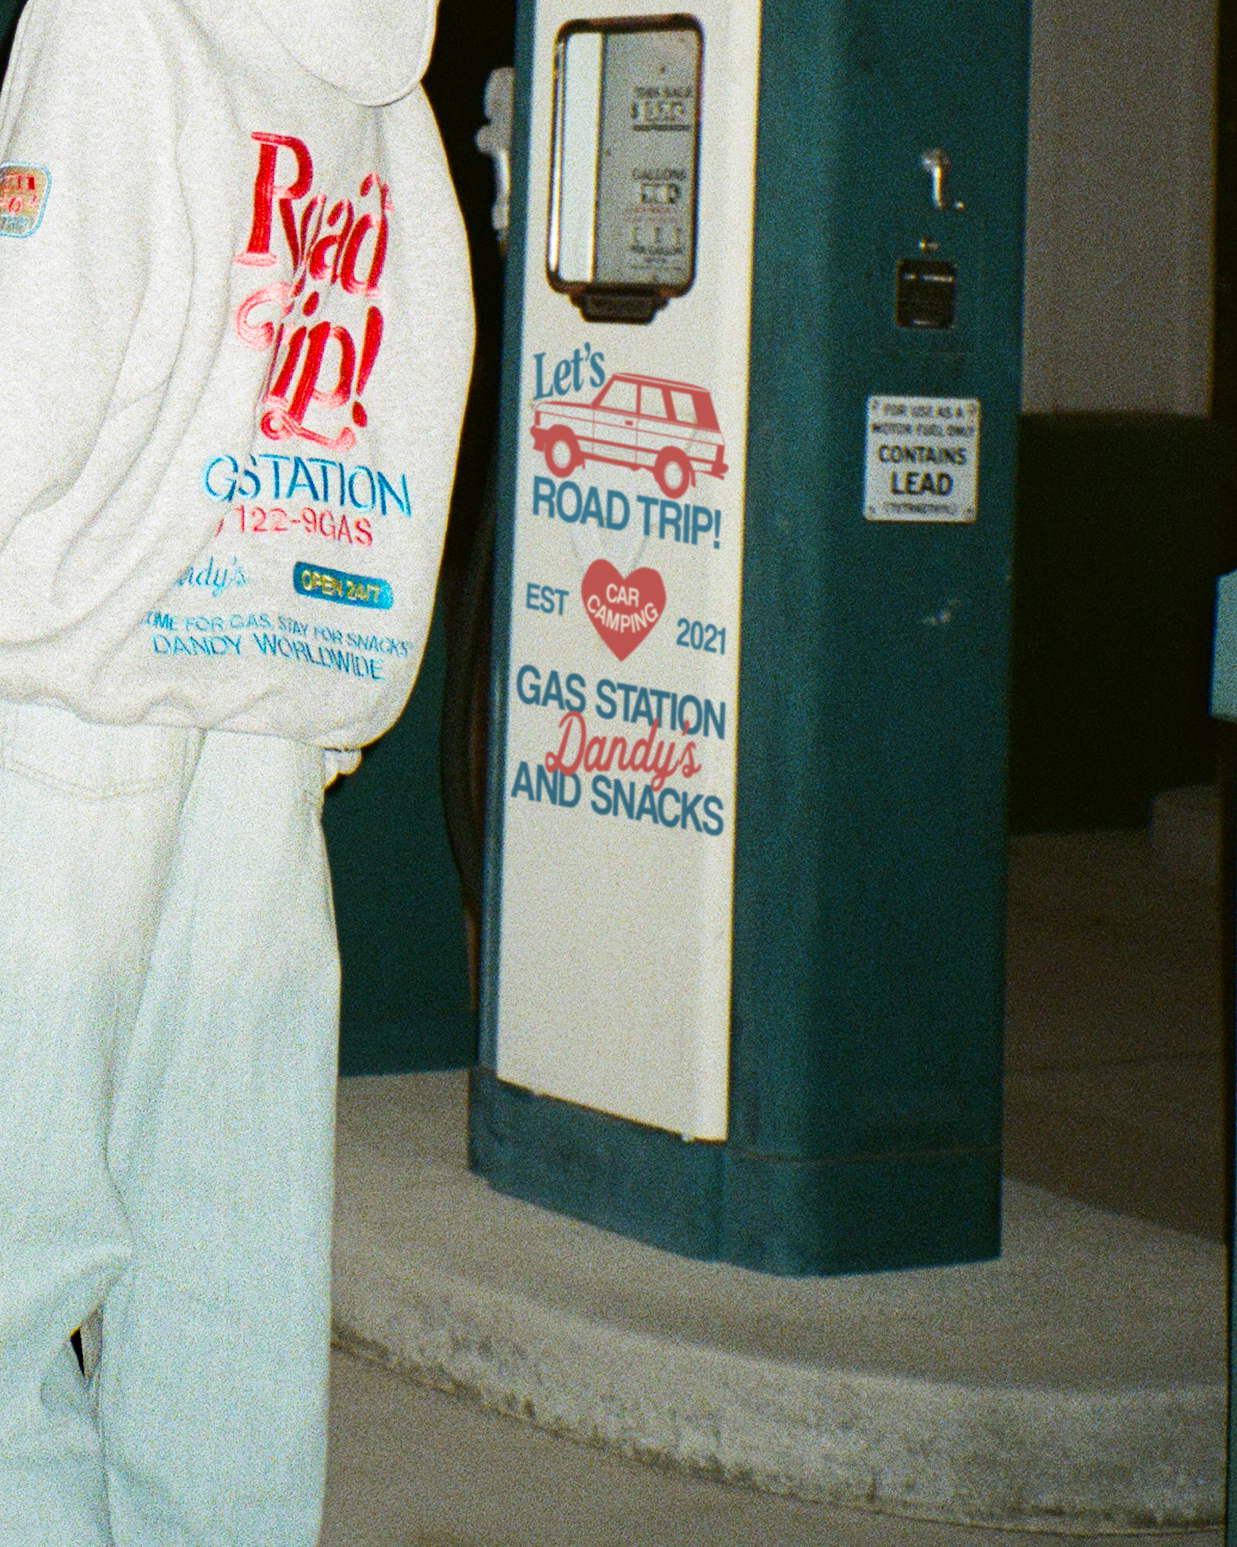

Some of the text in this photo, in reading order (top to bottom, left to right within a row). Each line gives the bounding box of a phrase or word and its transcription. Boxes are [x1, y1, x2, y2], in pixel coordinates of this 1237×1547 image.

[233, 131, 395, 299] Road
[532, 341, 606, 400] Let's
[878, 444, 968, 465] CONTAINS
[890, 471, 954, 496] LEAD
[532, 475, 722, 550] ROAD TRIP!
[301, 569, 382, 604] OPEN 24/7
[525, 583, 569, 616] EST
[605, 583, 640, 608] CAR
[185, 616, 224, 632] FOR
[278, 615, 309, 637] STAY
[313, 625, 344, 645] FOR
[586, 594, 659, 634] CAMPING
[675, 617, 727, 655] 2021
[152, 632, 385, 682] DANDY WORLDWIDE
[515, 664, 727, 741] GAS STATION
[544, 710, 703, 793] Dandy's
[510, 761, 725, 837] AND SNACKS
